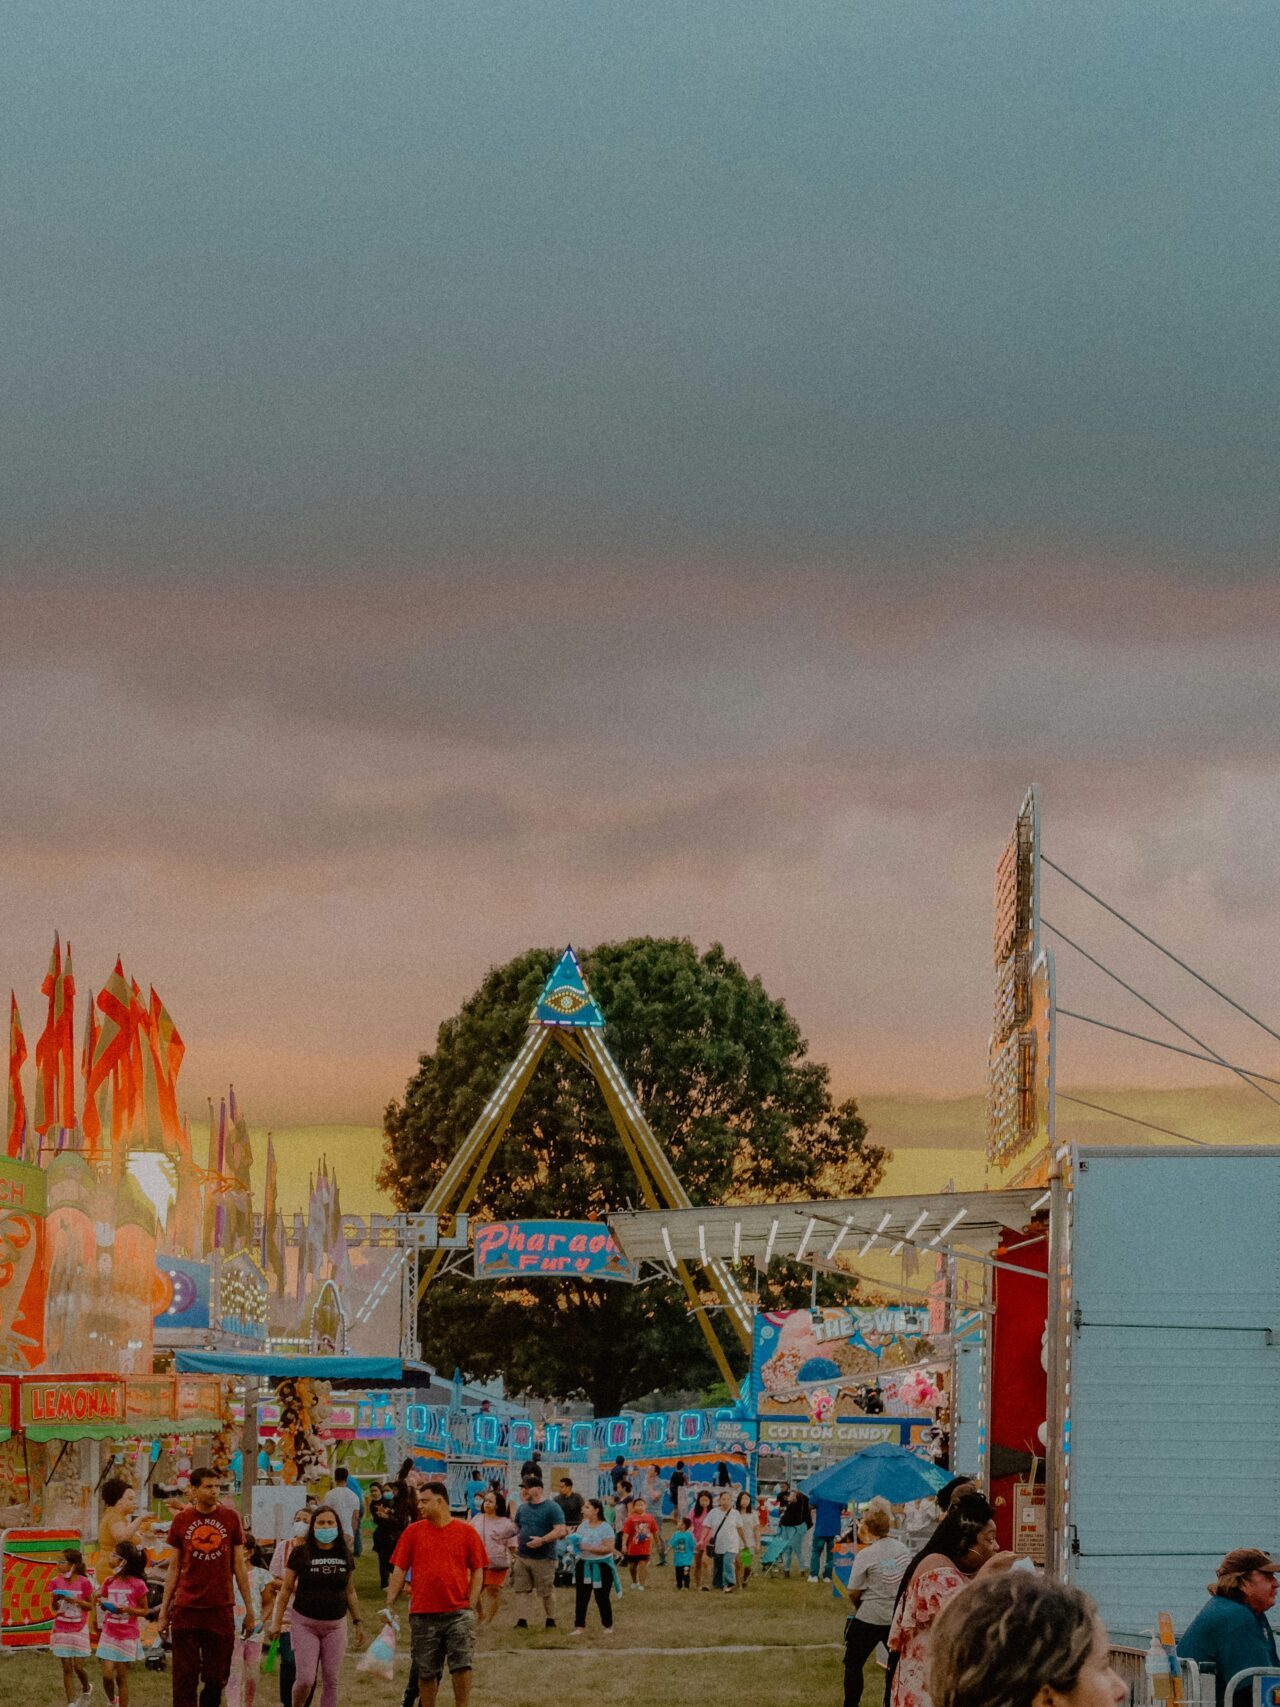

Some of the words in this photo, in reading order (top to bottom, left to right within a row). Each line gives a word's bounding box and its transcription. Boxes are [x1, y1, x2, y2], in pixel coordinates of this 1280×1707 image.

[518, 1254, 592, 1272] Fury
[811, 1314, 857, 1346] THE
[767, 1426, 833, 1440] COTTON
[837, 1426, 893, 1442] CANDY
[184, 1519, 204, 1541] SANTA
[203, 1517, 229, 1540] MONICA
[192, 1549, 223, 1561] BEACH
[322, 1565, 337, 1575] 87
